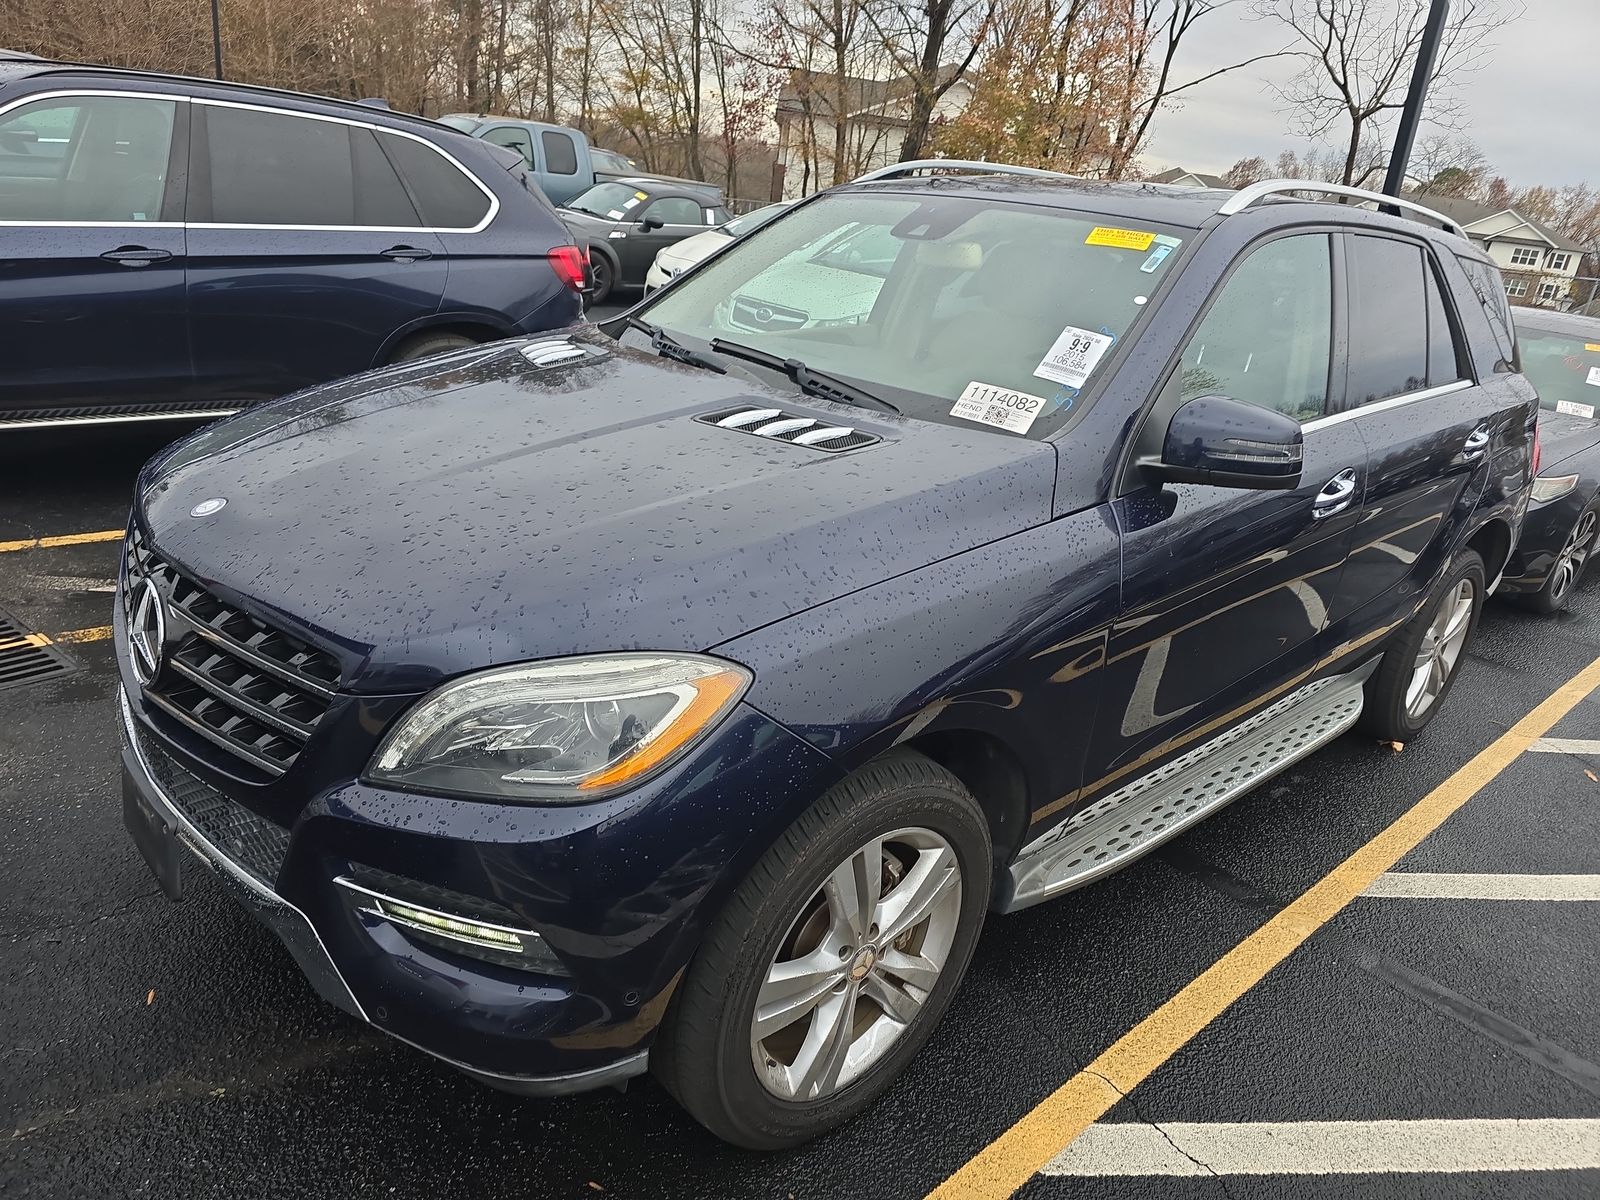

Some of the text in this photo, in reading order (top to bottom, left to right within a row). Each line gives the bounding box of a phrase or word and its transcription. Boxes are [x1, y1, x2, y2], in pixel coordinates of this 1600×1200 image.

[1069, 338, 1091, 354] 9:9
[1063, 349, 1087, 361] 2015
[956, 401, 983, 412] HEND
[970, 386, 1039, 414] 1114082
